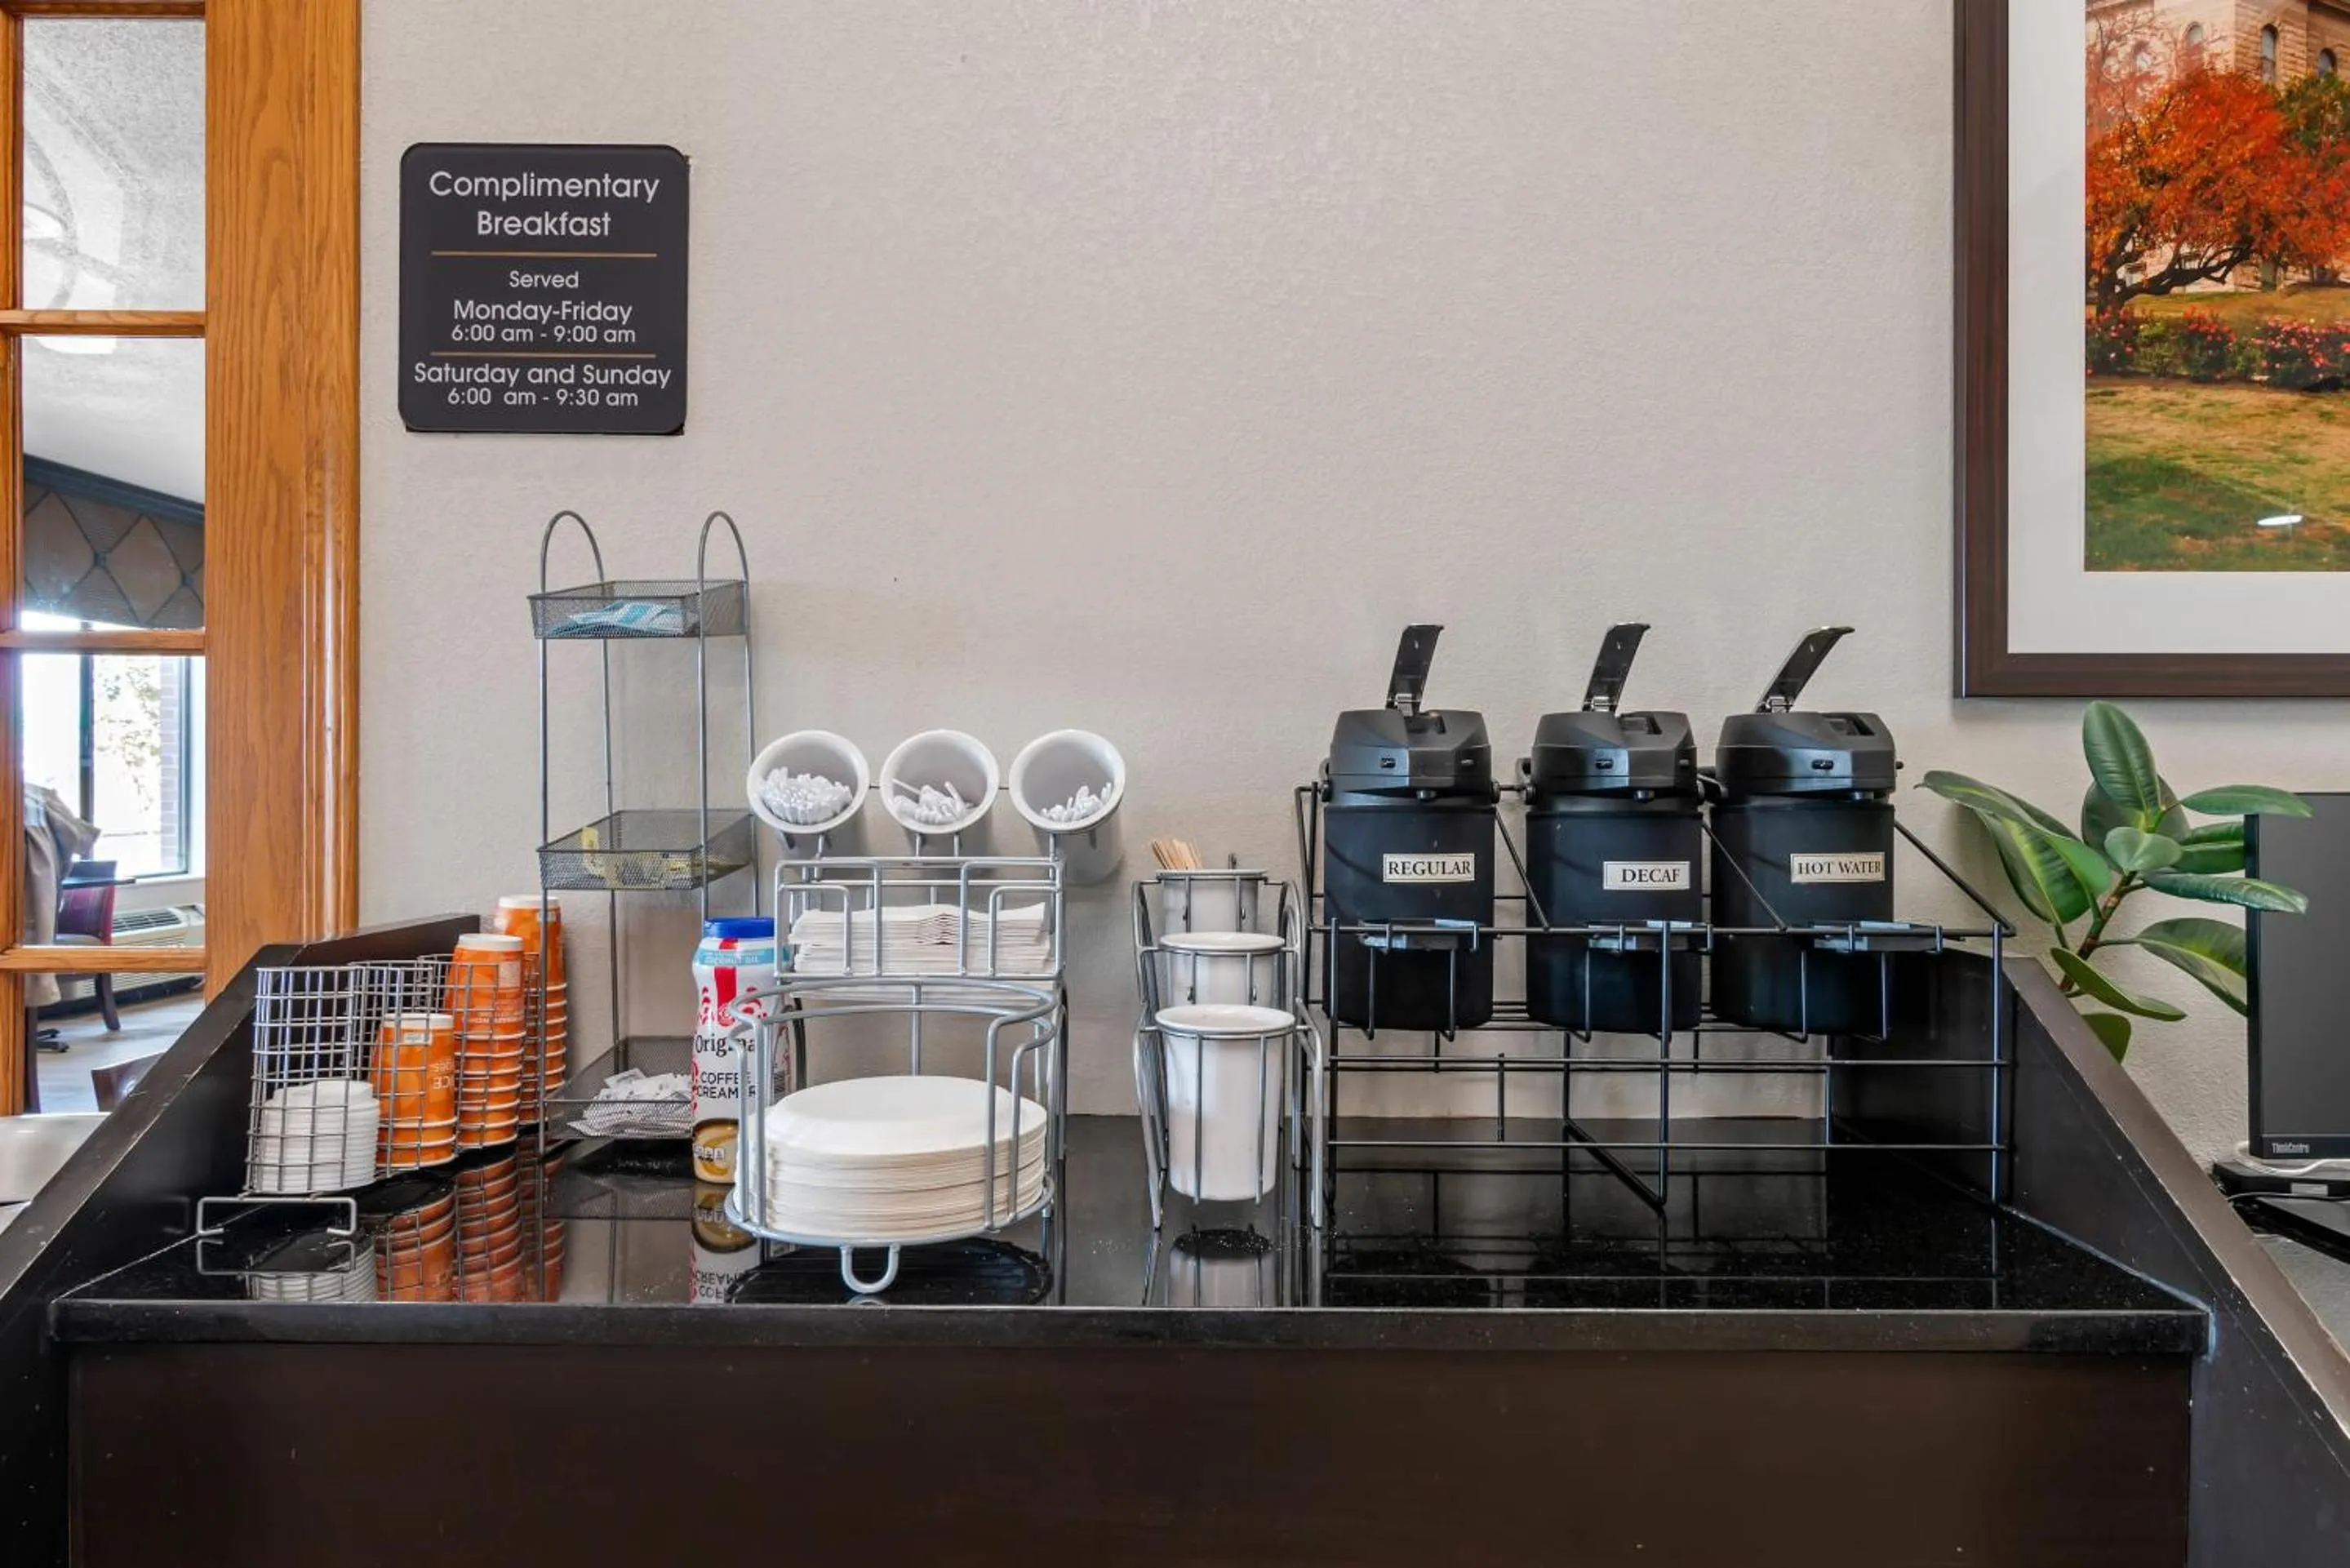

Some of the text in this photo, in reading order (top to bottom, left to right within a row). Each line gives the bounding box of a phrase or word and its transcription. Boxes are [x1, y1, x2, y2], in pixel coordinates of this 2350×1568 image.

[429, 171, 660, 203] Complimentary
[477, 211, 611, 237] Breakfast
[509, 270, 580, 288] Served
[454, 300, 633, 325] Monday-Friday
[451, 324, 495, 342] 6:00
[500, 327, 534, 342] am
[553, 325, 597, 343] 9:00
[603, 329, 636, 343] am
[414, 362, 672, 389] Saturday and Sunday
[447, 387, 491, 406] 6:00
[503, 391, 536, 406] am
[556, 388, 600, 406] 9:30
[606, 392, 638, 406] am
[1388, 860, 1470, 875] REGULAR
[1621, 868, 1681, 883] DECAF
[1798, 860, 1881, 874] HOT WATER
[698, 1085, 756, 1099] CREAMR
